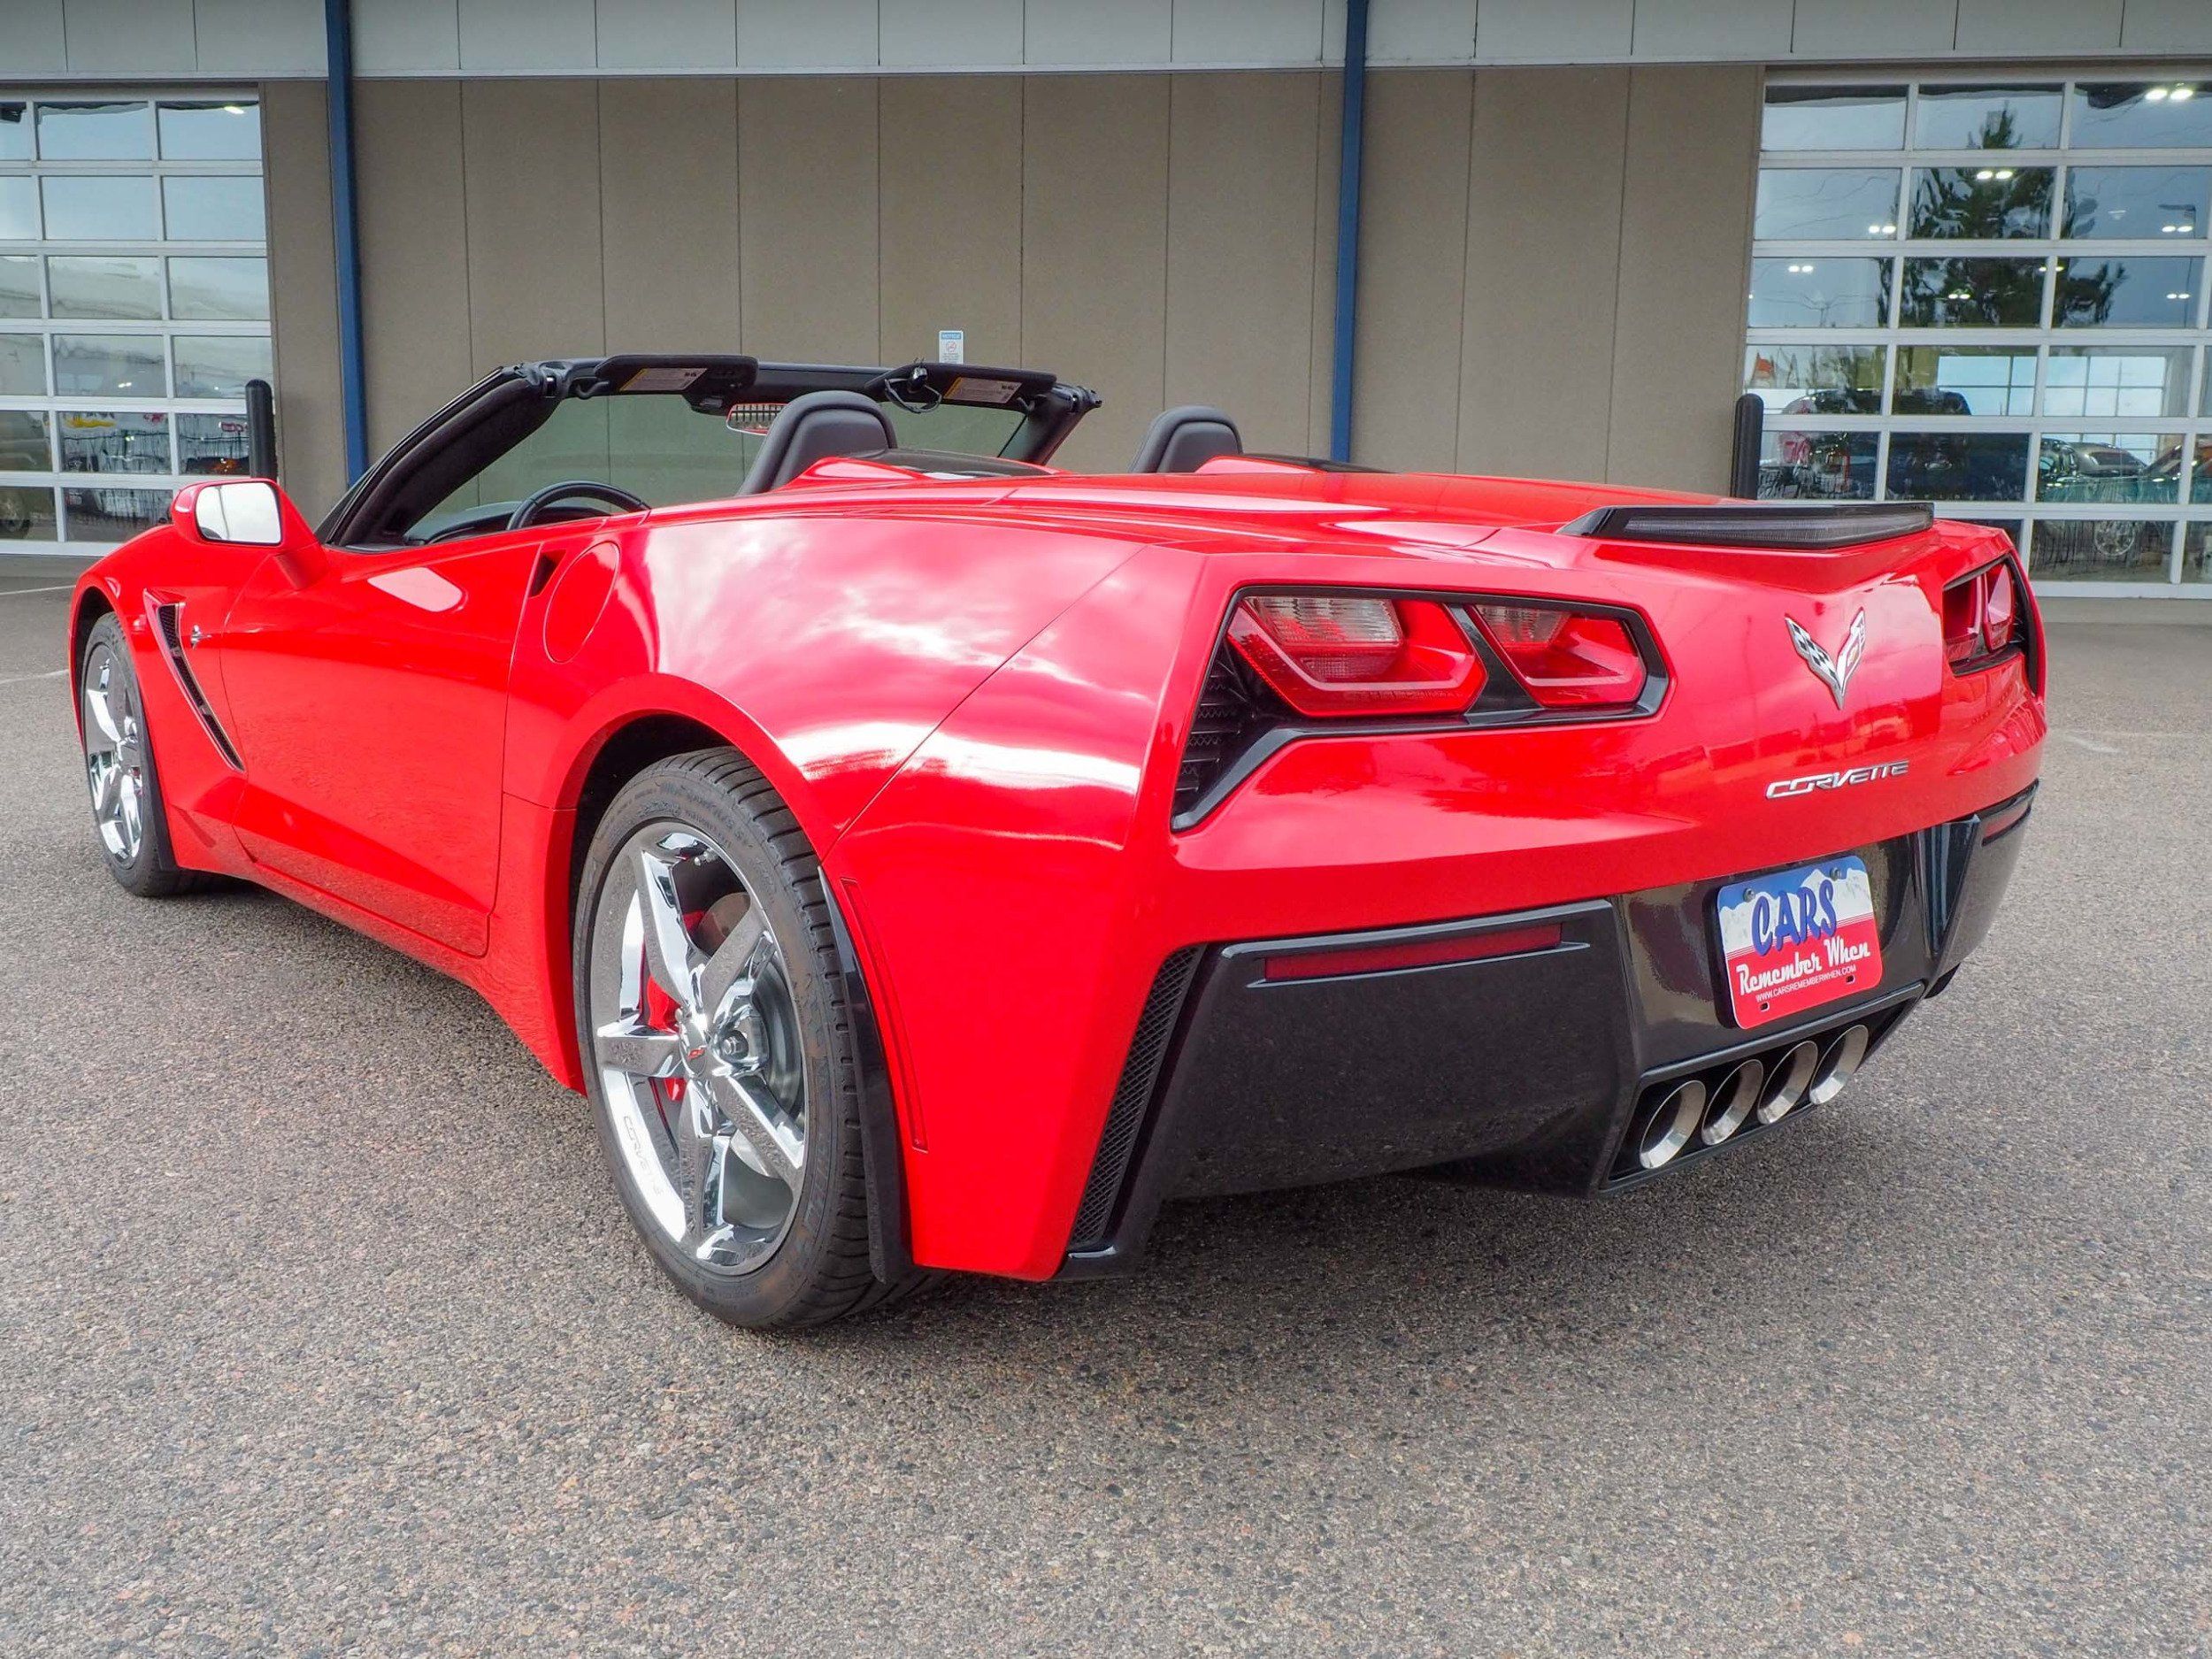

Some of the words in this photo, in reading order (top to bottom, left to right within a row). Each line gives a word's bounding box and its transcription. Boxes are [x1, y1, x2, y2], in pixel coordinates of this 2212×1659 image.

[1766, 760, 1909, 799] CORVETTE
[1751, 879, 1838, 956] CARS
[1735, 952, 1822, 996] Remember
[1824, 935, 1871, 968] When
[1755, 964, 1857, 1002] WWW.CARSREMEMBERWHEN.COM
